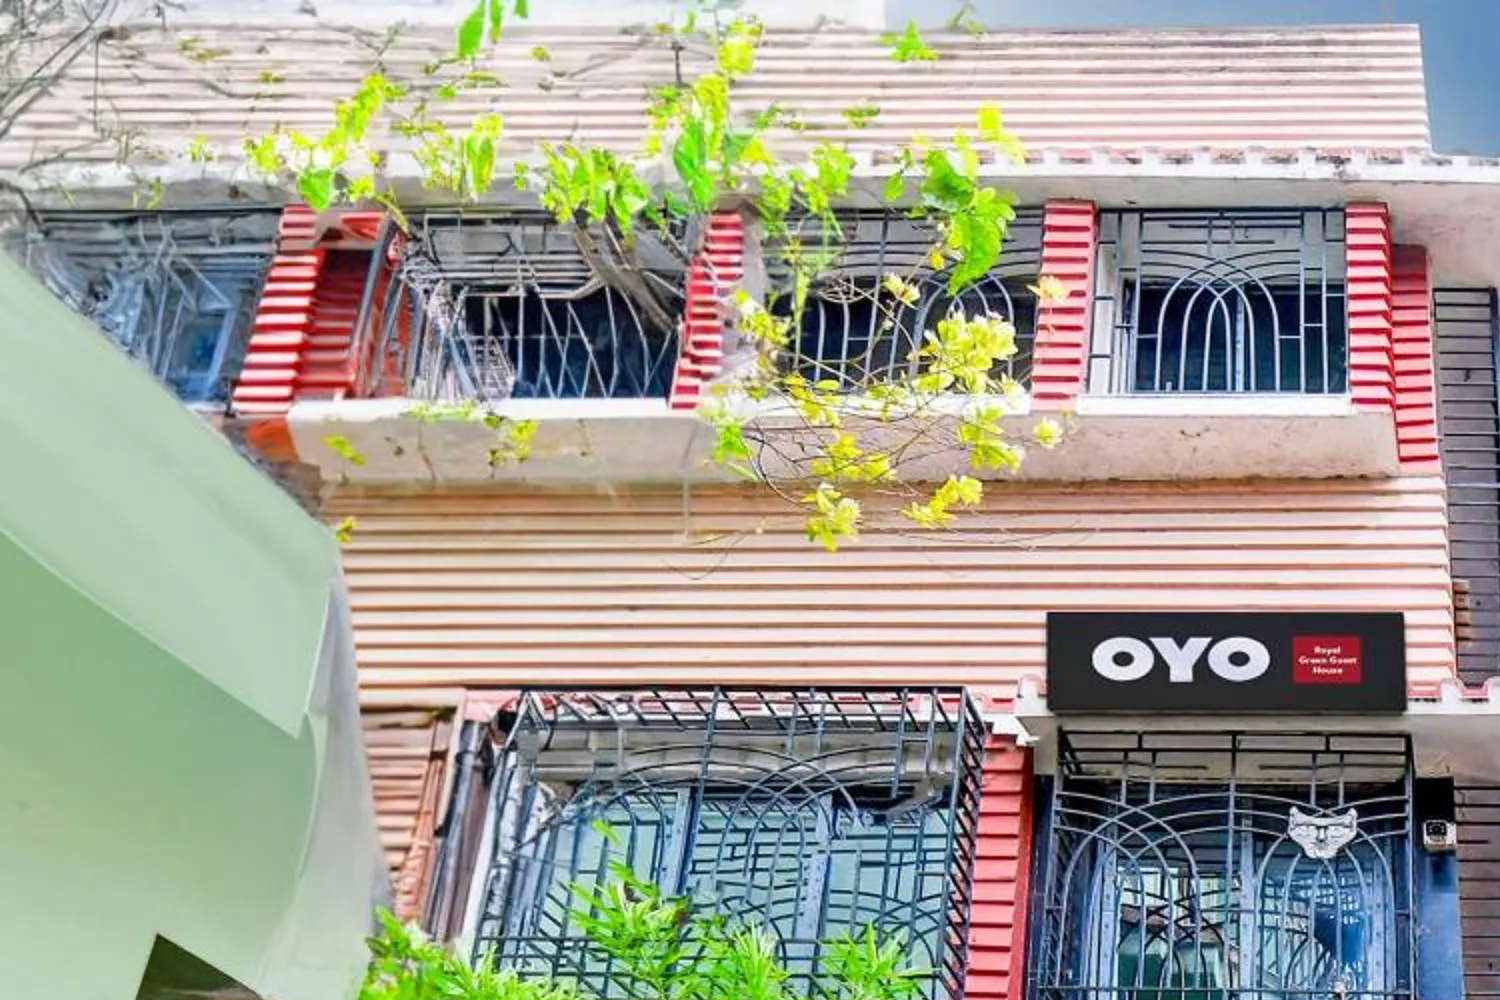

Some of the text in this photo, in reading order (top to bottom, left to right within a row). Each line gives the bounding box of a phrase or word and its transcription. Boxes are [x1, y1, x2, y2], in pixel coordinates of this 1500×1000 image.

[1314, 645, 1341, 656] Royal
[1091, 636, 1271, 683] OYO
[1312, 666, 1343, 675] House
